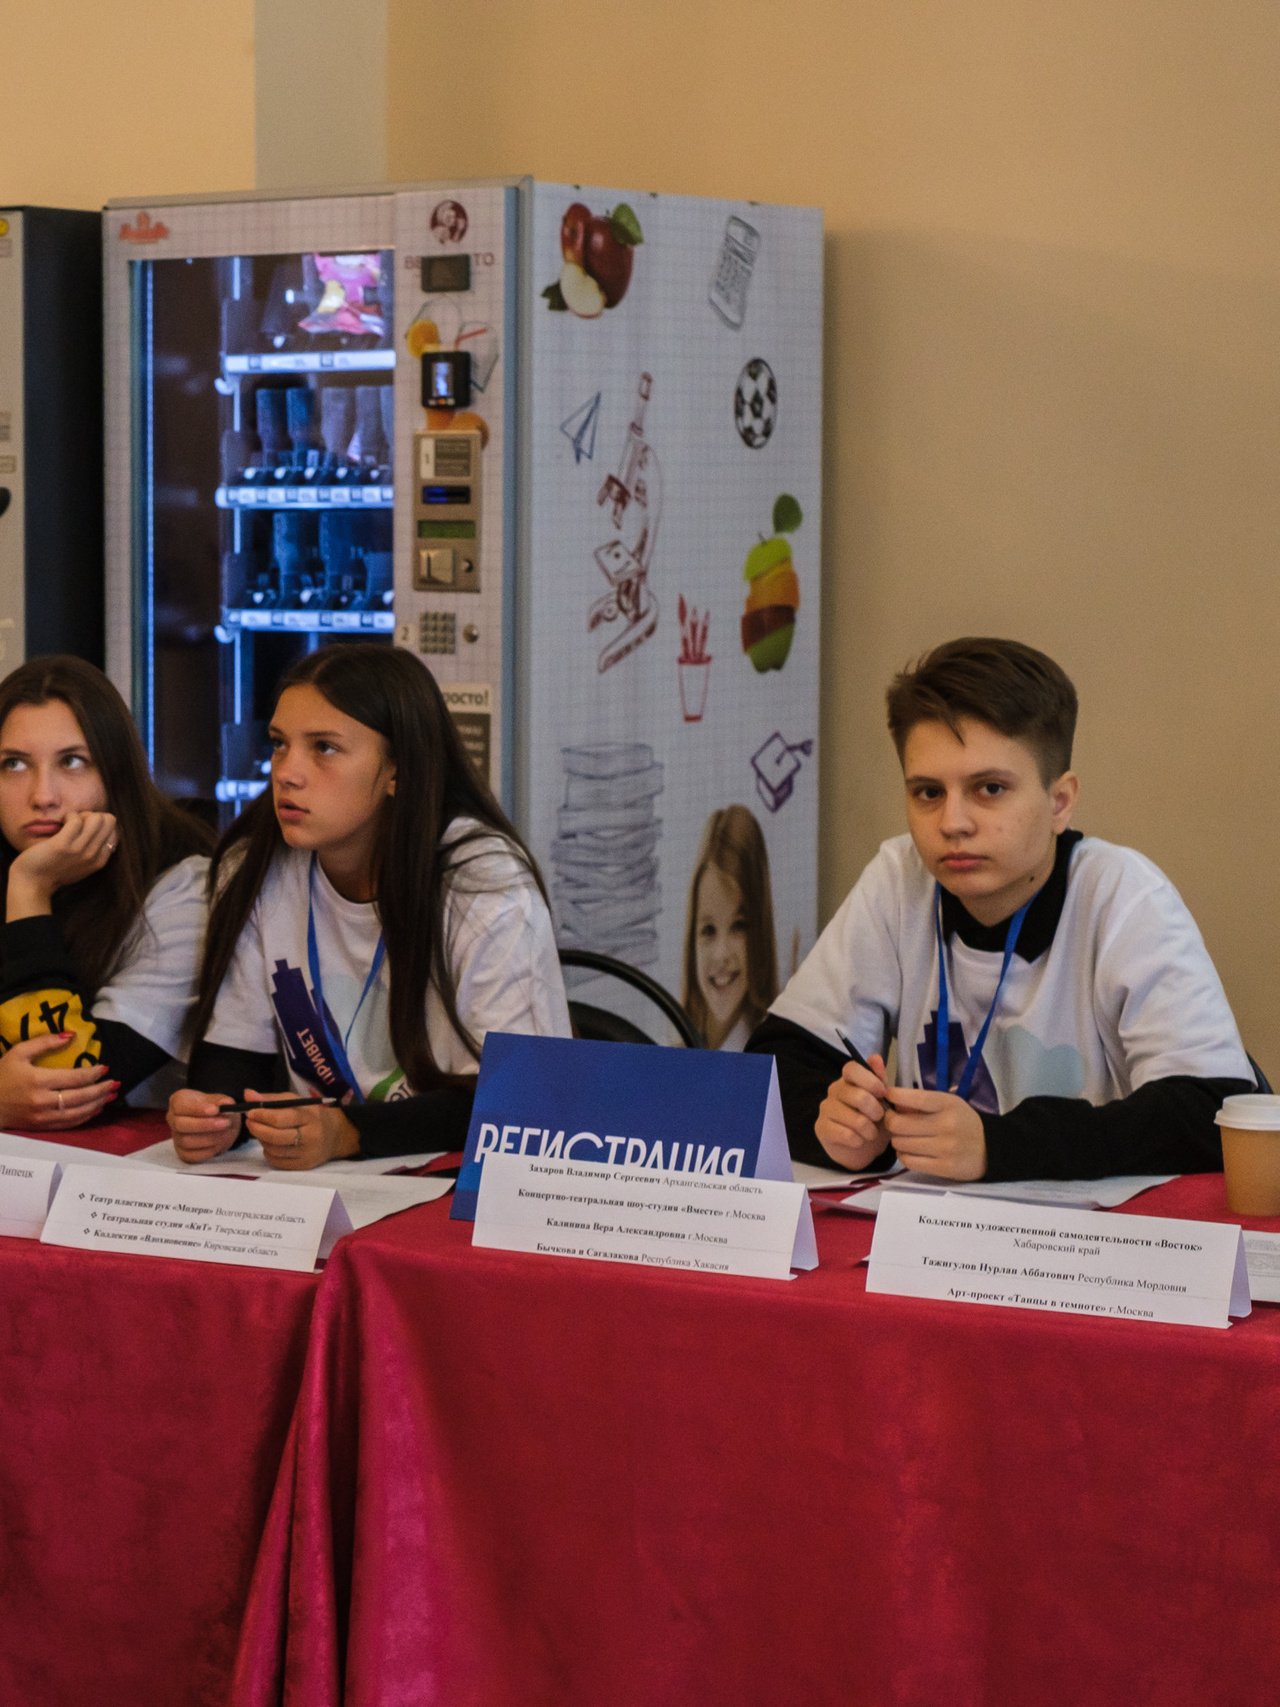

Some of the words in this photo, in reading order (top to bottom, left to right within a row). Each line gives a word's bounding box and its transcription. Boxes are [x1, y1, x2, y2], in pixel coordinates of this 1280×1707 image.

[296, 1028, 336, 1086] ПРИВЕТ
[528, 1163, 564, 1175] Захаров
[566, 1167, 611, 1180] Владимир
[613, 1172, 661, 1184] Сергеевич
[662, 1177, 727, 1191] Архангельская
[729, 1184, 763, 1194] область
[89, 1194, 113, 1205] Театр
[115, 1198, 154, 1209] пластики
[155, 1202, 171, 1211] рук
[172, 1203, 213, 1214] «Модерн»
[215, 1208, 274, 1222] Волгоградская
[275, 1213, 306, 1224] область
[518, 1188, 624, 1207] Концертно-театральная
[627, 1202, 678, 1212] шоу-студия
[681, 1205, 723, 1216] «Вместе»
[725, 1210, 766, 1221] г.Москва
[101, 1213, 154, 1226] Театральная
[155, 1219, 183, 1229] студия
[215, 1225, 250, 1237] Тверская
[252, 1228, 282, 1239] область
[546, 1217, 590, 1230] Калинина
[593, 1222, 614, 1234] Вера
[616, 1226, 686, 1240] Александровна
[688, 1232, 728, 1244] г.Москва
[918, 1215, 972, 1229] Коллектив
[975, 1223, 1057, 1237] художественной
[1059, 1231, 1152, 1247] самодеятельности
[1154, 1239, 1203, 1251] «Восток»
[93, 1229, 138, 1241] Коллектив
[140, 1234, 201, 1247] «Вдохновение»
[203, 1241, 246, 1253] Кировская
[247, 1245, 278, 1256] область
[536, 1242, 576, 1255] Бычкова
[586, 1248, 639, 1261] Сагалакова
[641, 1253, 691, 1267] Республика
[692, 1259, 730, 1271] Хакасия
[1013, 1238, 1076, 1253] Хабаровский
[1078, 1246, 1101, 1257] край
[921, 1256, 977, 1271] Тажигулов
[979, 1263, 1018, 1275] Нурлан
[1020, 1267, 1075, 1281] Аббатович
[1077, 1273, 1134, 1287] Республика
[1136, 1279, 1187, 1293] Мордовия
[947, 1287, 1004, 1301] Арт-проект
[1007, 1294, 1048, 1306] «Танцы
[1060, 1302, 1106, 1312] темноте»
[1108, 1305, 1154, 1318] г.Москва
